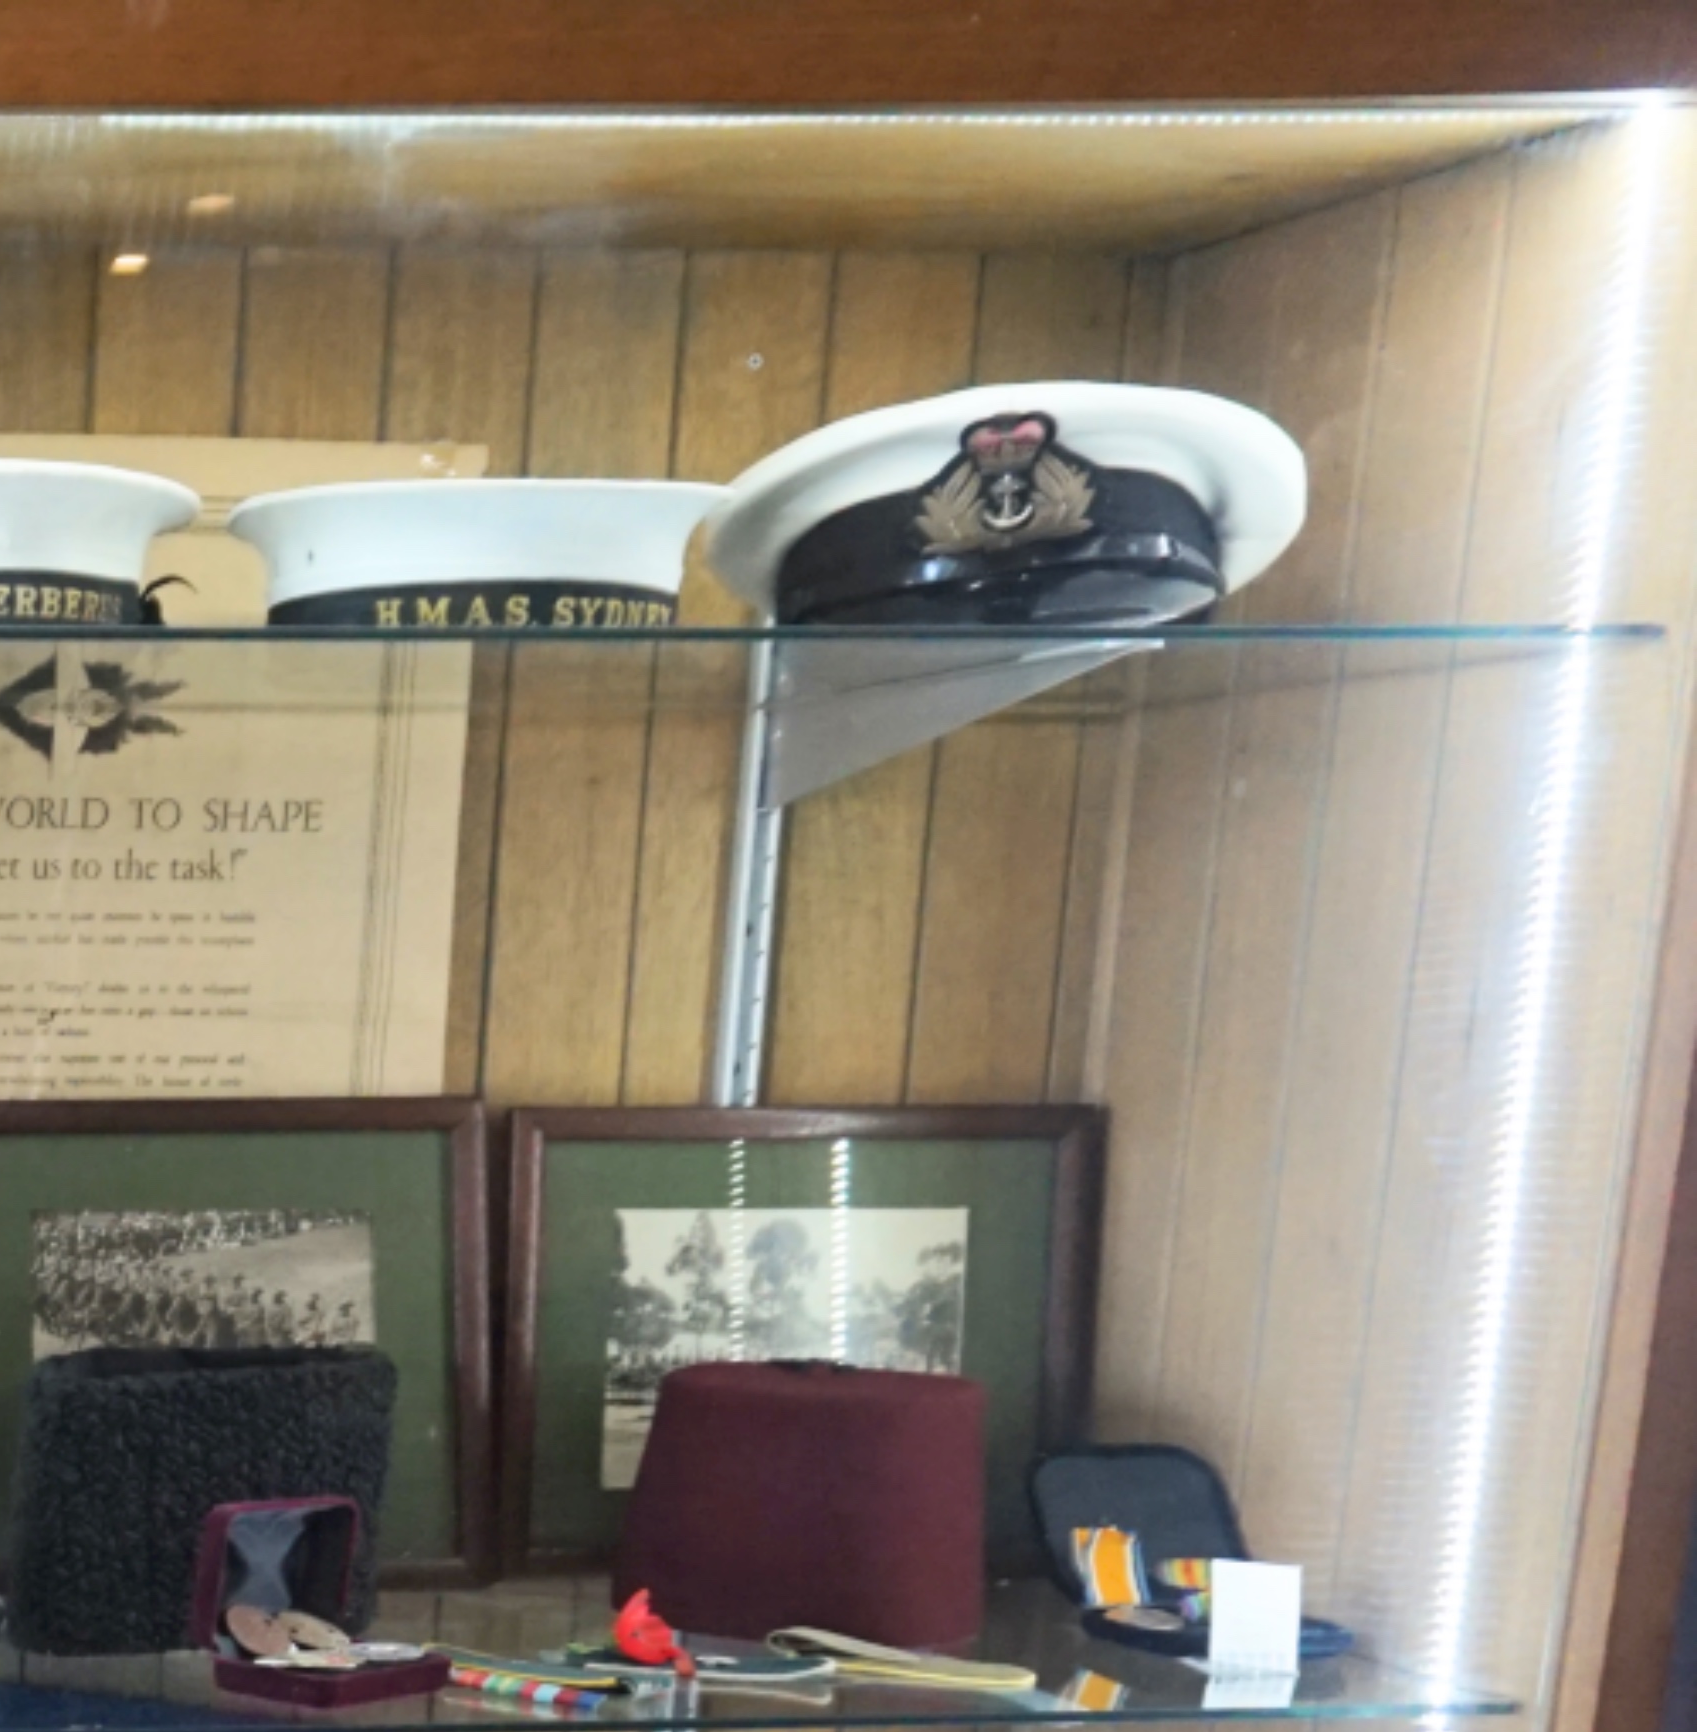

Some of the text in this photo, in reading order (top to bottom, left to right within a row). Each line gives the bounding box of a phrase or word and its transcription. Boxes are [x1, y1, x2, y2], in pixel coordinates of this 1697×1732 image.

[129, 798, 183, 831] TO
[203, 798, 324, 833] SHAPE
[33, 856, 62, 880] us
[71, 850, 103, 881] to
[114, 848, 158, 881] the
